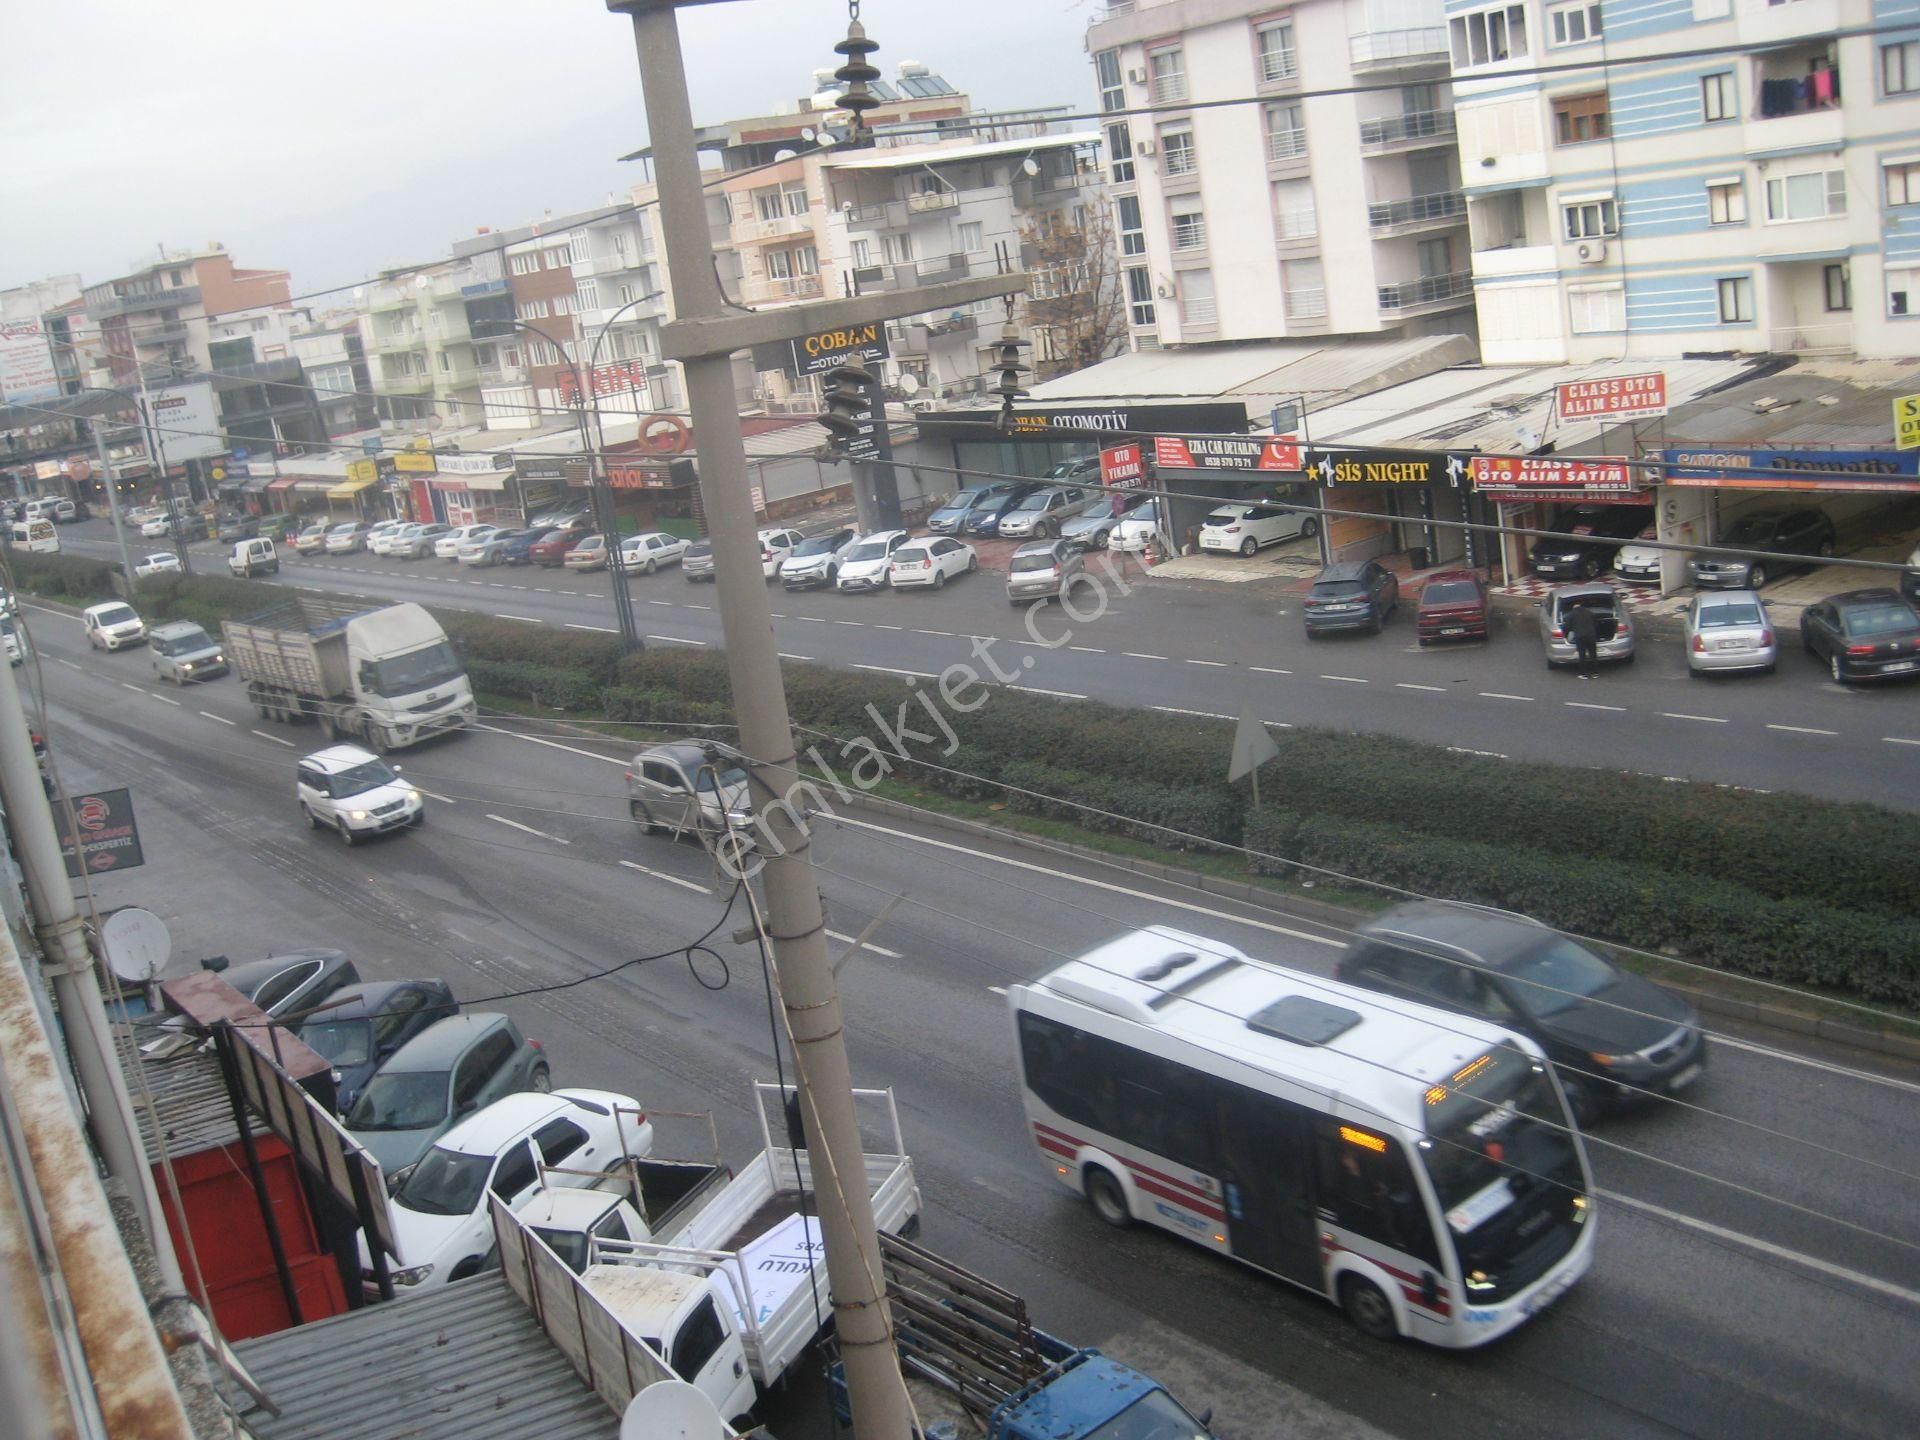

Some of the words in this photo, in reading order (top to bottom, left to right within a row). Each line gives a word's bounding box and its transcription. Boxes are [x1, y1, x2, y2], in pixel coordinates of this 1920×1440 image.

[804, 326, 877, 357] ÇOBAN
[1568, 381, 1620, 398] CLASS
[1625, 377, 1656, 392] OTO
[1565, 397, 1605, 414] ALIM
[1610, 392, 1661, 409] SATIM
[1053, 410, 1128, 431] OTOMOTİV
[1114, 449, 1130, 464] OTO
[1521, 459, 1572, 470] CLASS
[1107, 462, 1140, 481] YIKAMA
[1335, 458, 1362, 482] SİS
[1365, 462, 1430, 483] NIGHT
[1478, 470, 1512, 482] OTO
[1517, 470, 1561, 482] ALIM
[1566, 470, 1622, 482] SATIM
